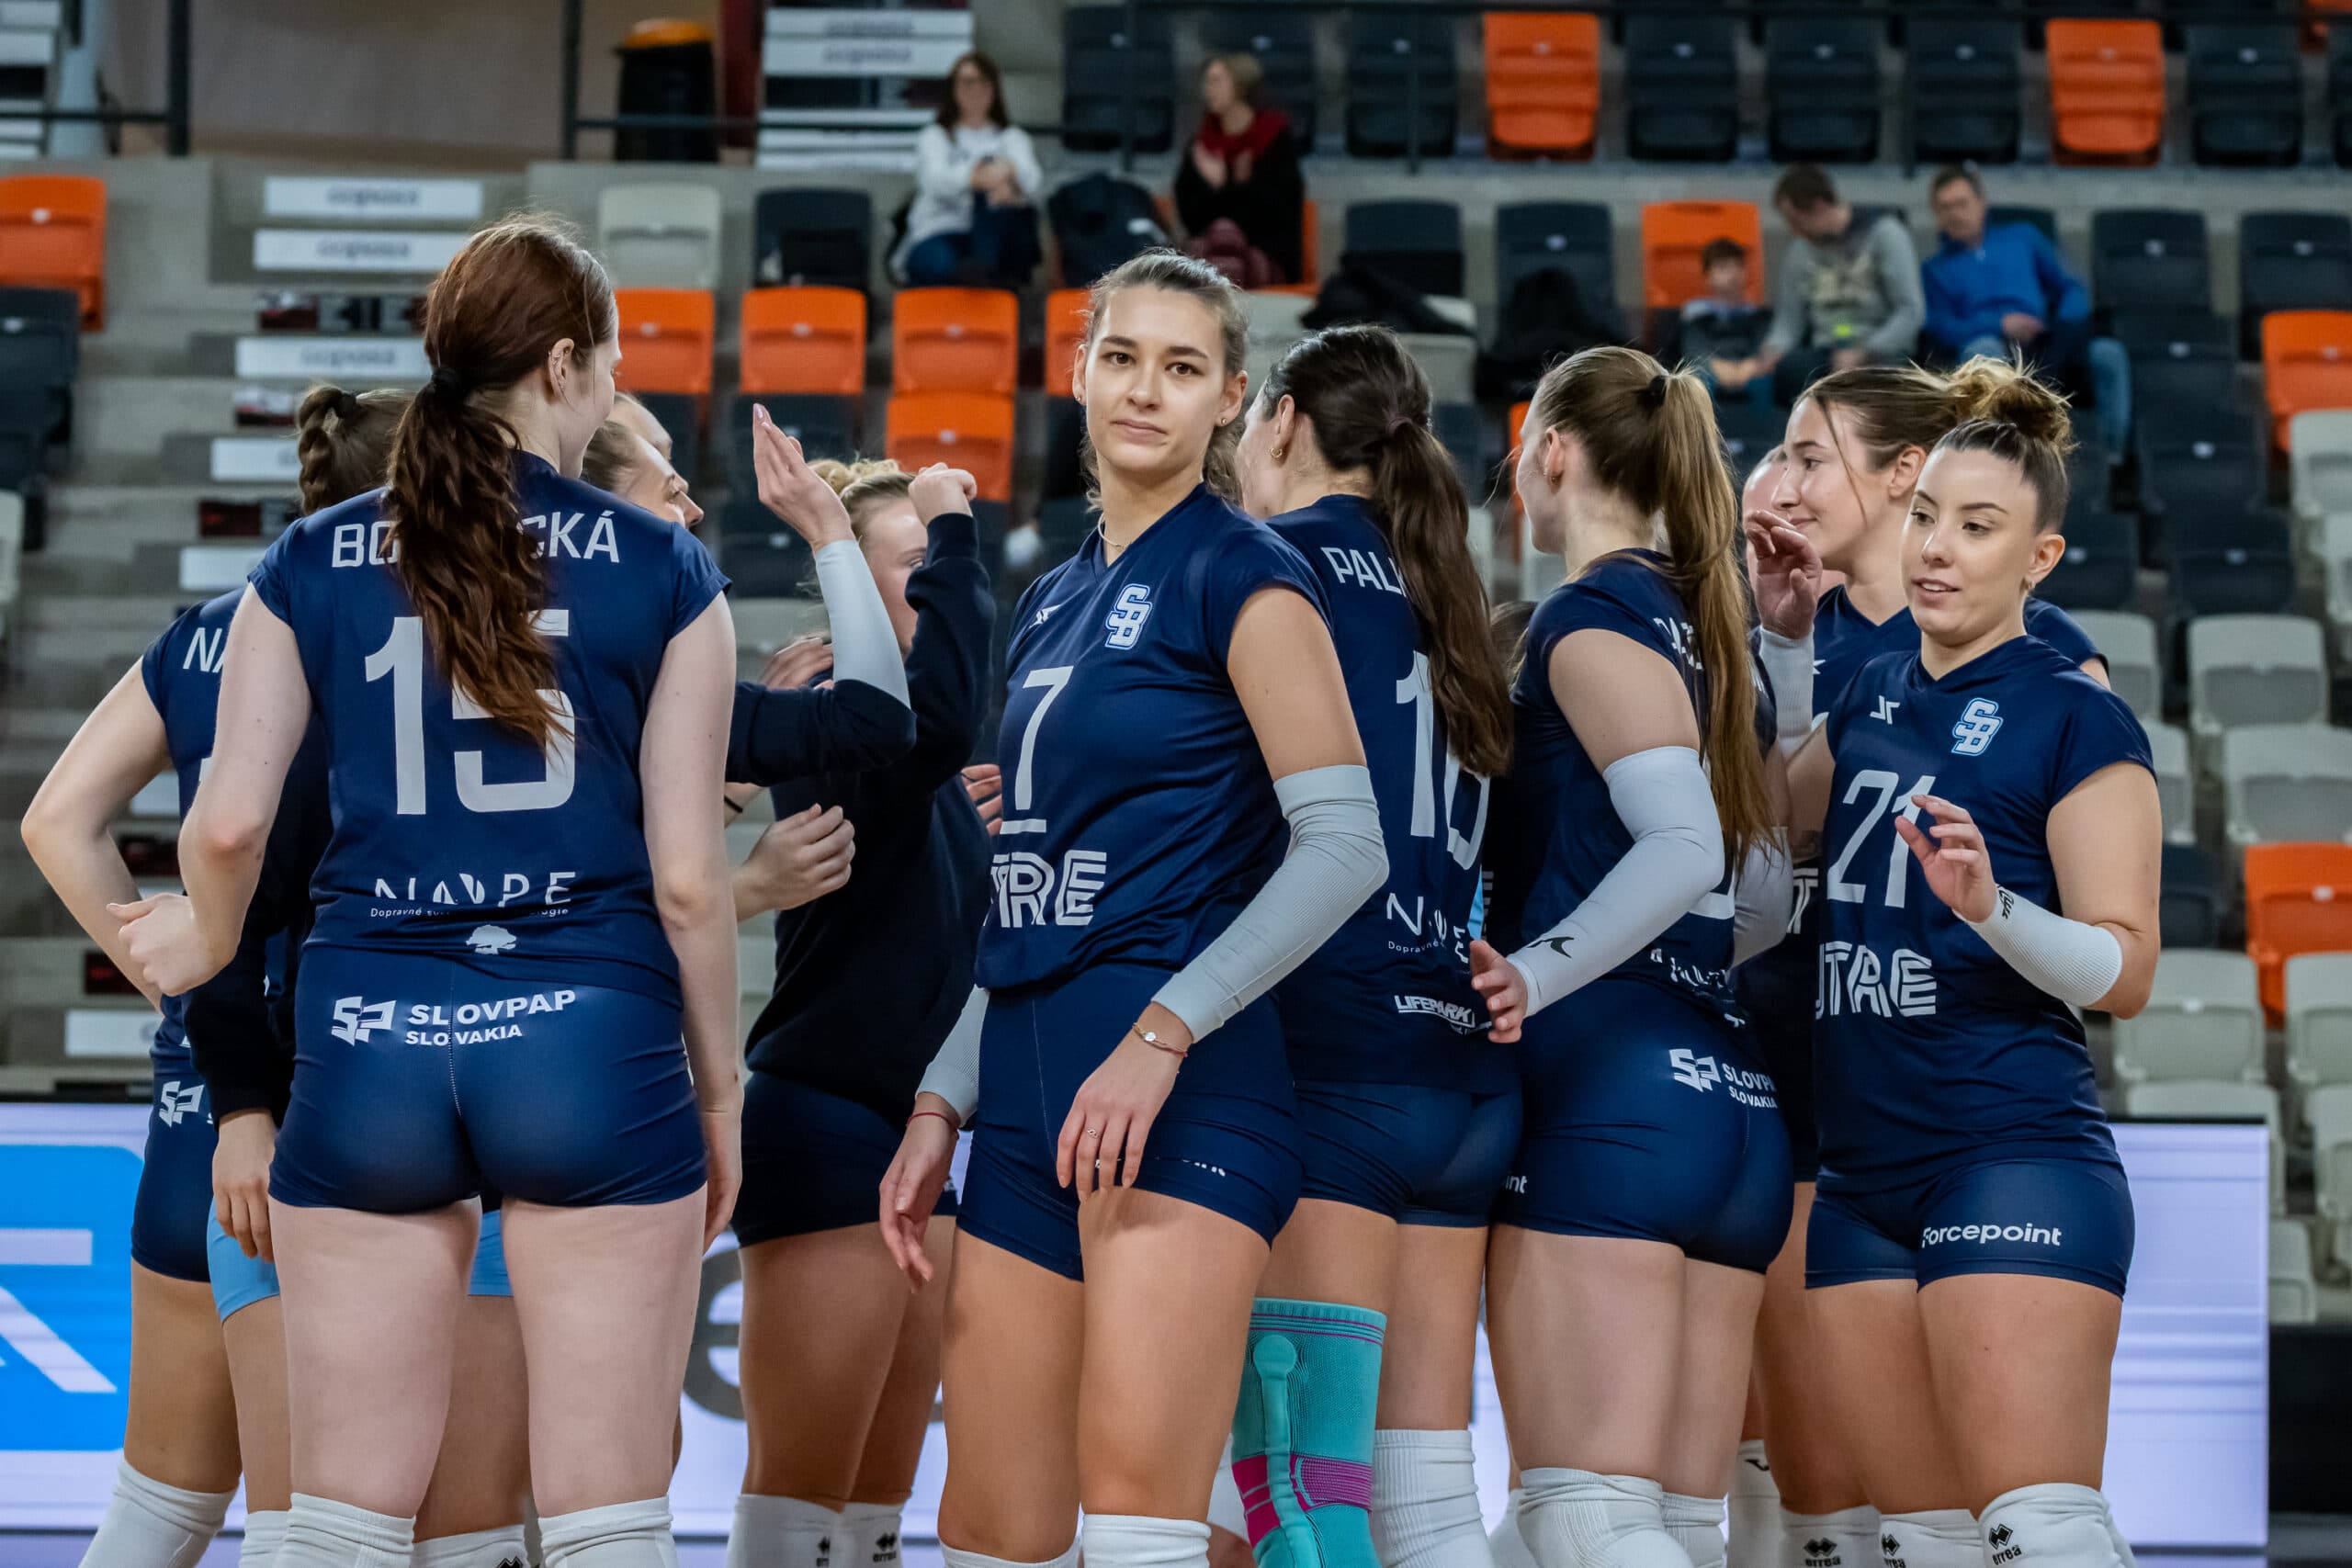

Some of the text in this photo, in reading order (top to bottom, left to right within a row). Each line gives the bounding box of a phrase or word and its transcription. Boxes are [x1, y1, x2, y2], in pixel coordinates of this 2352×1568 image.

[332, 510, 620, 569] BOCKÁ
[365, 609, 575, 815] 15
[1014, 666, 1074, 810] 7
[1826, 769, 1936, 908] 21
[407, 989, 576, 1025] SLOVPAP
[1394, 995, 1472, 1022] LIFEPARK
[404, 1024, 523, 1046] SLOVAKIA
[1728, 1086, 1779, 1108] SLOVAKIA
